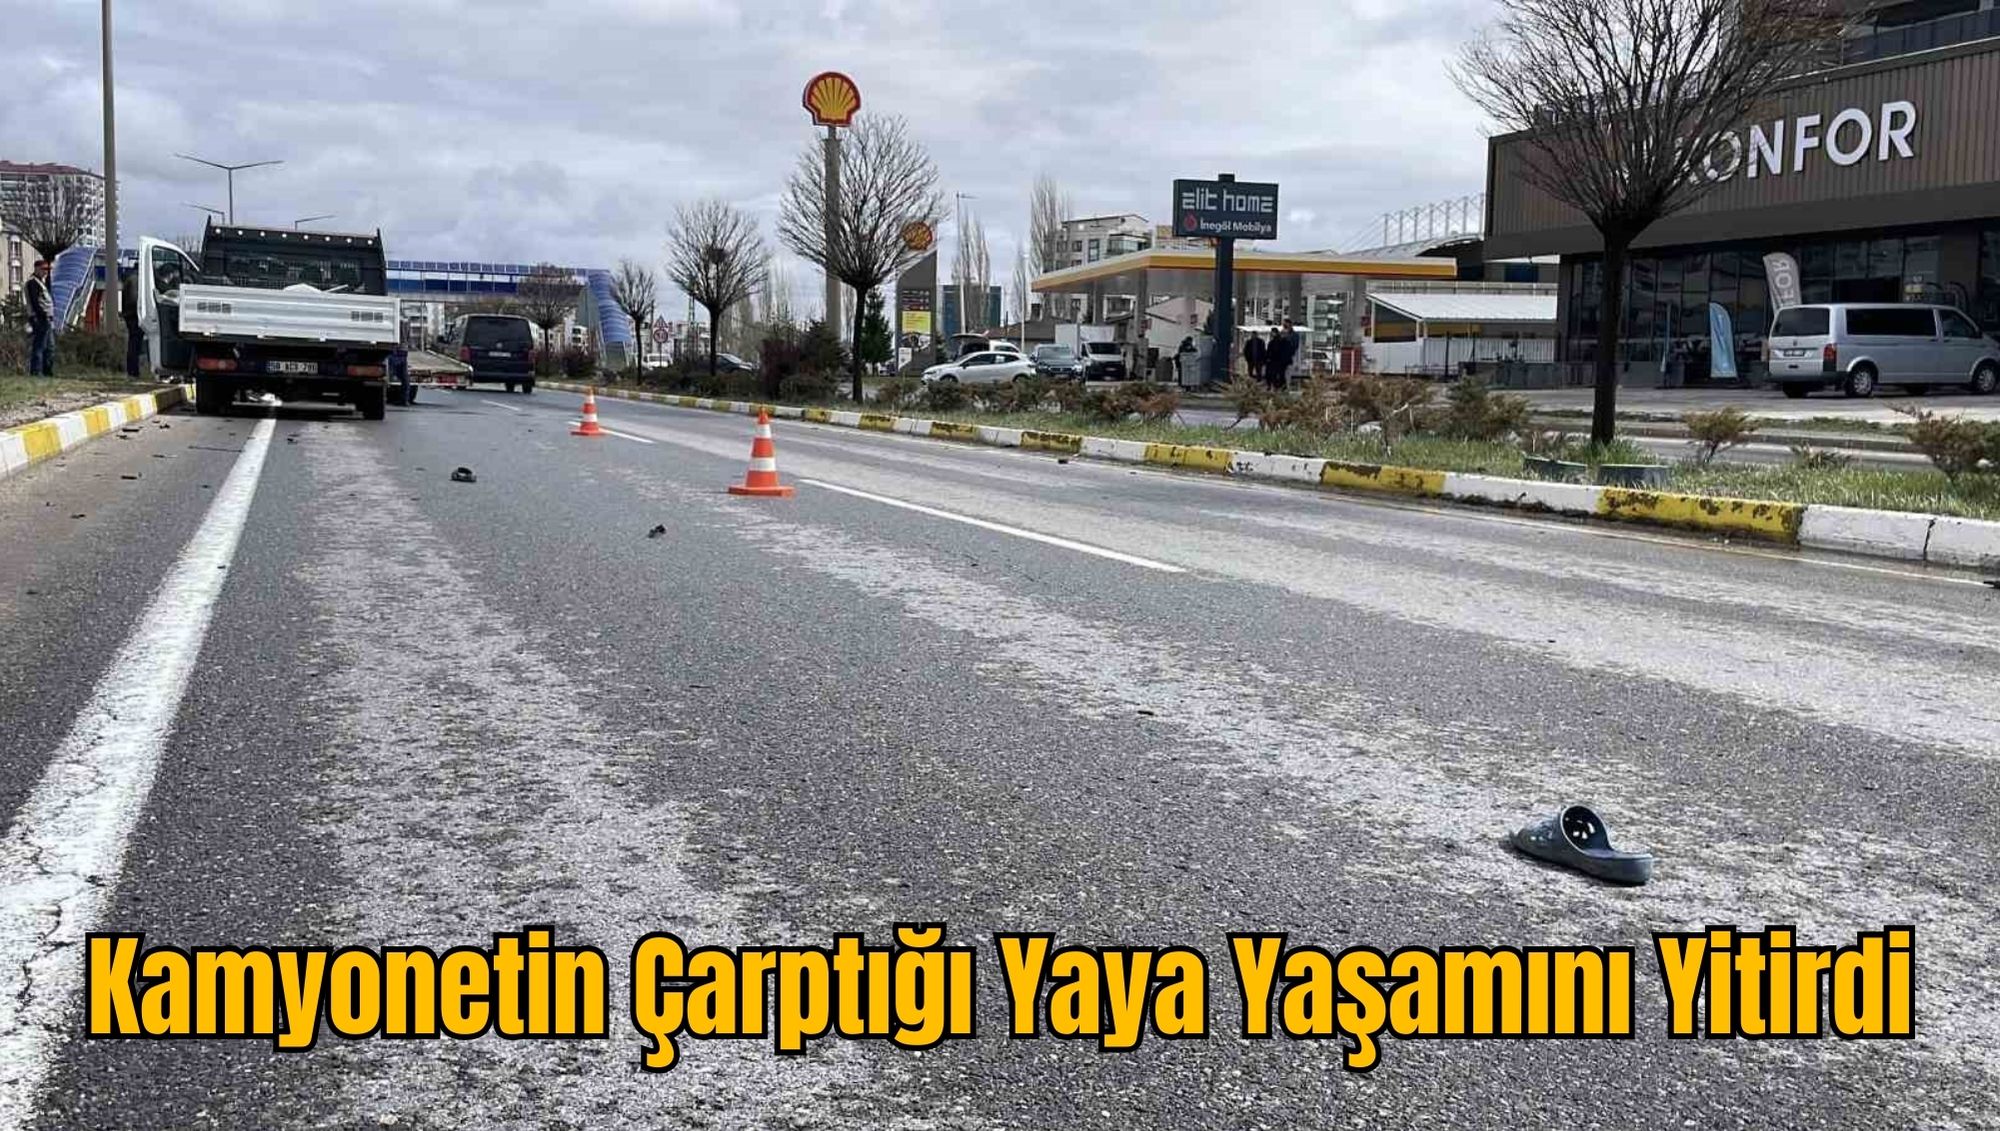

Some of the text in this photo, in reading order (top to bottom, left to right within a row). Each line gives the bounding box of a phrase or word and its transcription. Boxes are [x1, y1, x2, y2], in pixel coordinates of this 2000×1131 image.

[1181, 187, 1274, 213] elit home
[1233, 220, 1272, 234] Mobilya
